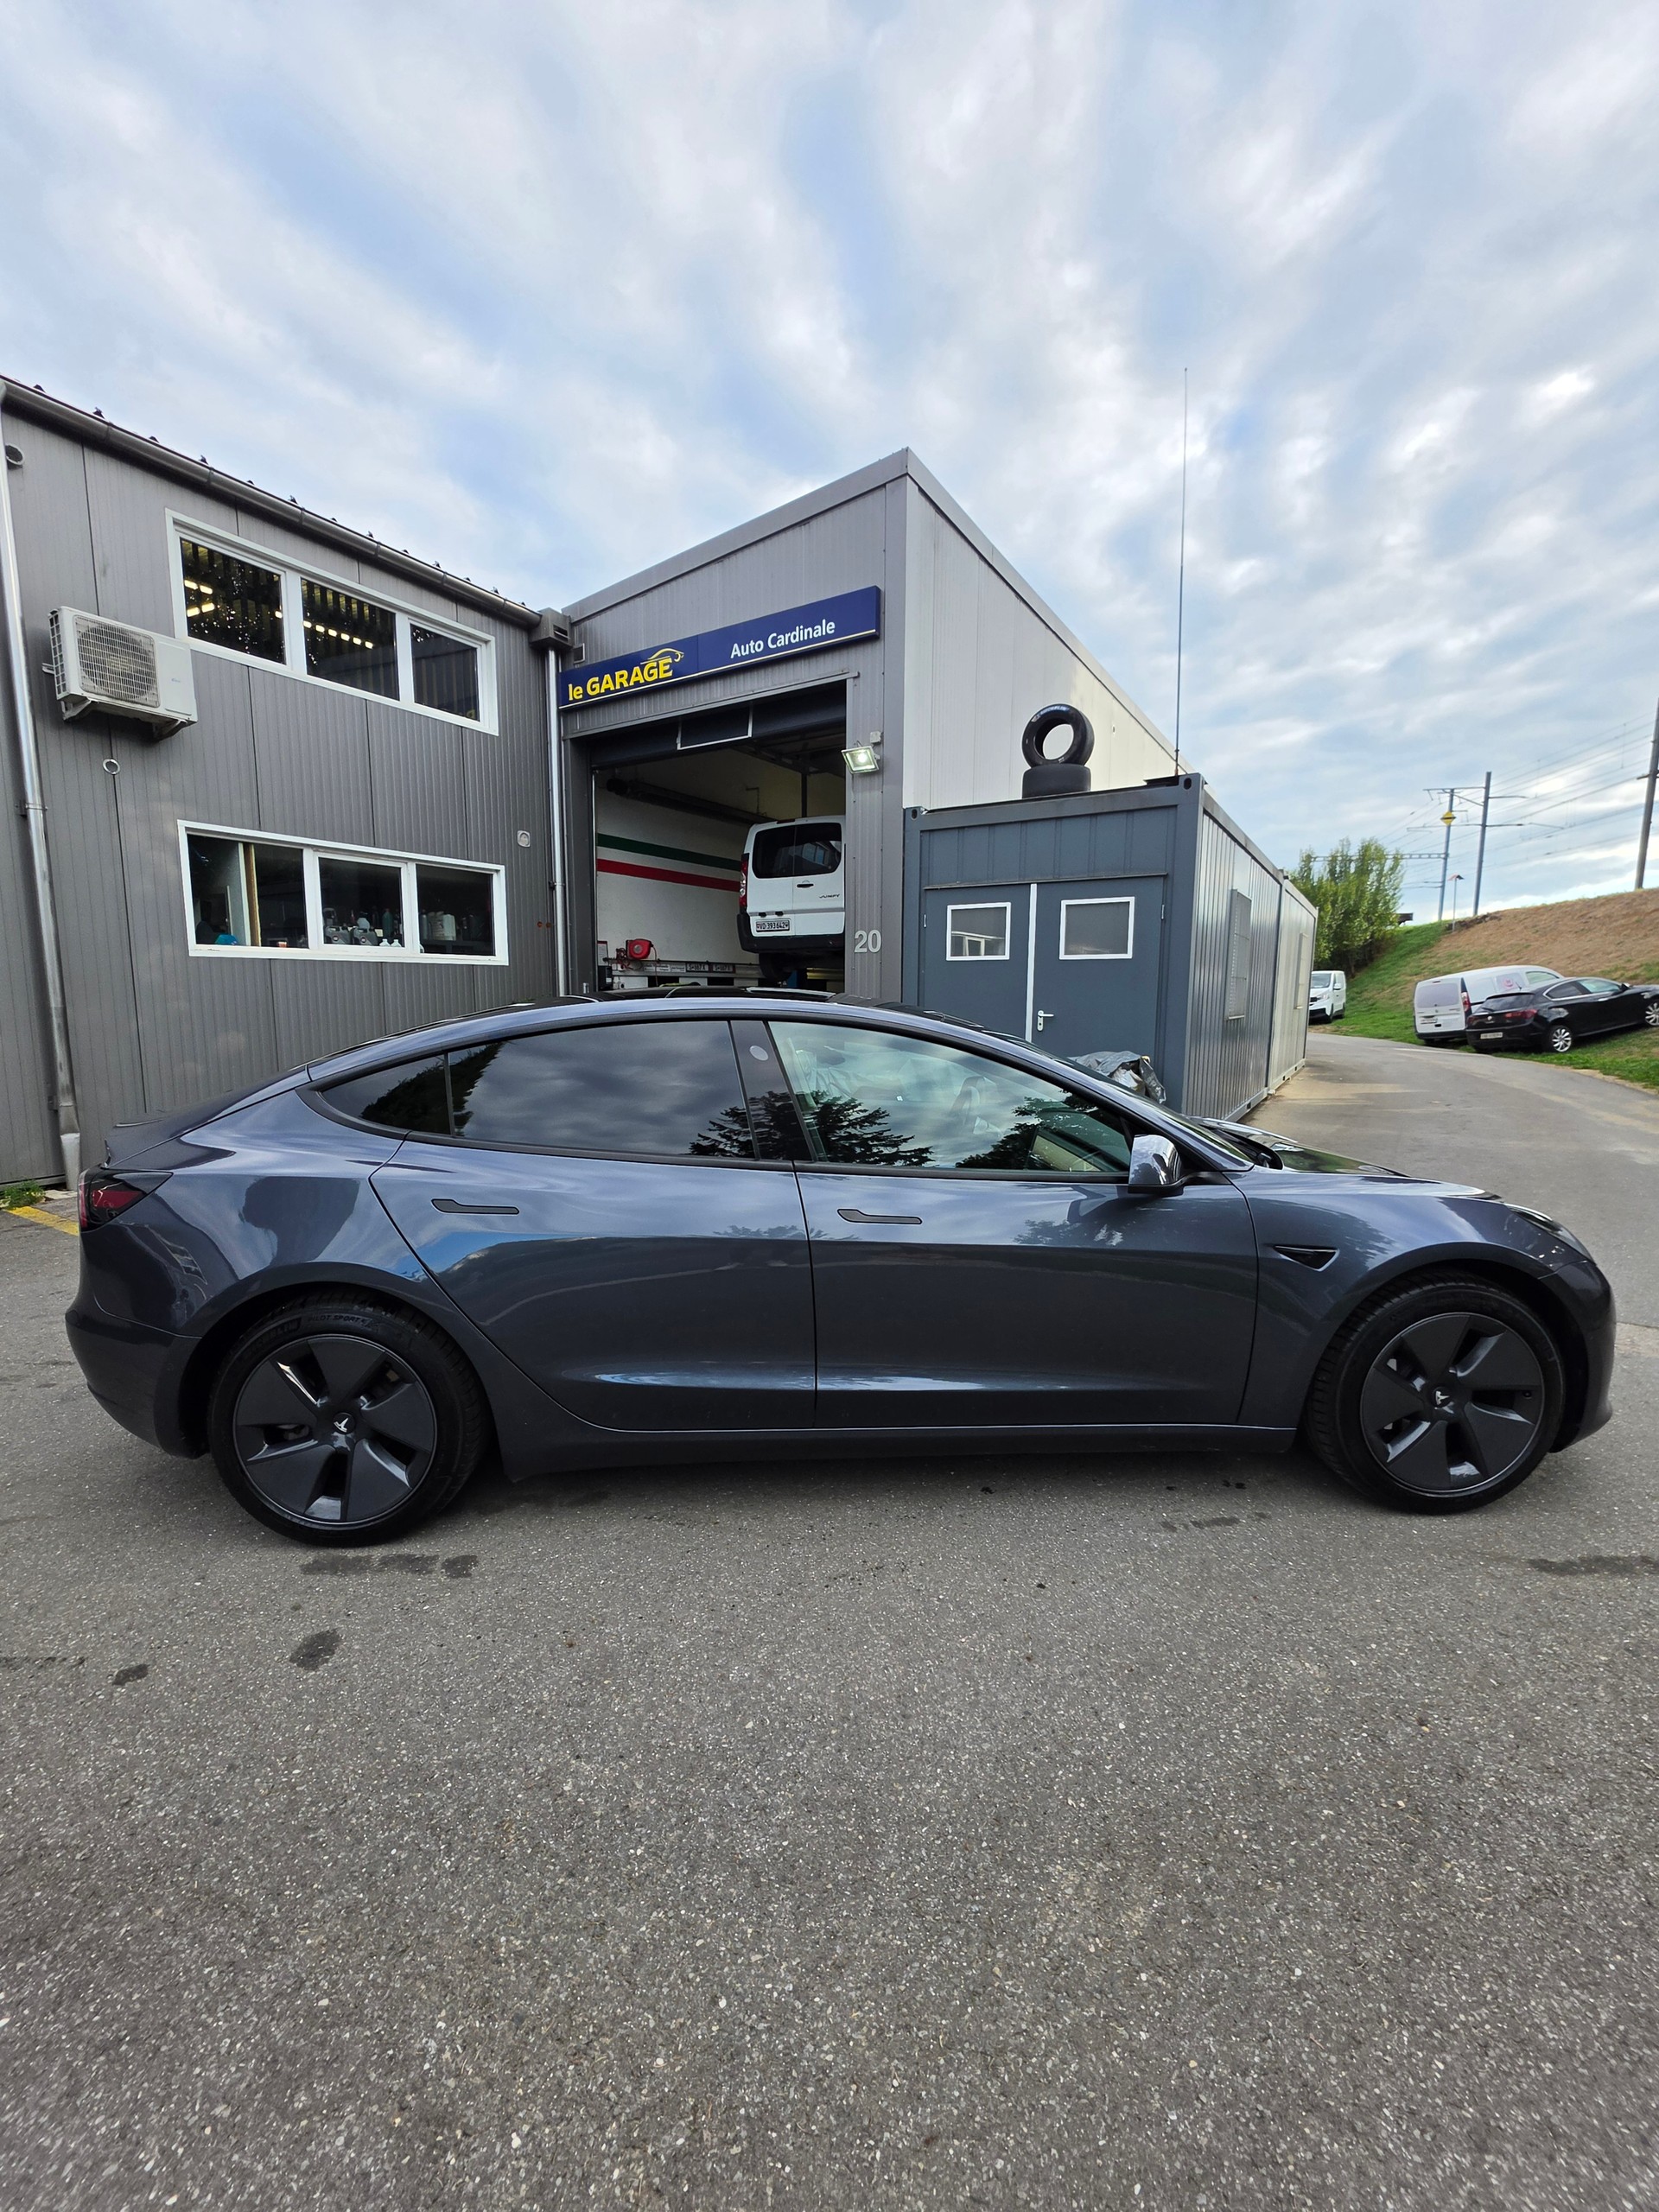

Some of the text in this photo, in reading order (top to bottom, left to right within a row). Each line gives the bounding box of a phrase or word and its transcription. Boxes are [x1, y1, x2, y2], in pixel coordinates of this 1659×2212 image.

[730, 619, 836, 658] Auto Cardinale
[568, 658, 673, 701] le GARAGE
[854, 929, 882, 953] 20
[333, 1314, 361, 1324] SPORT
